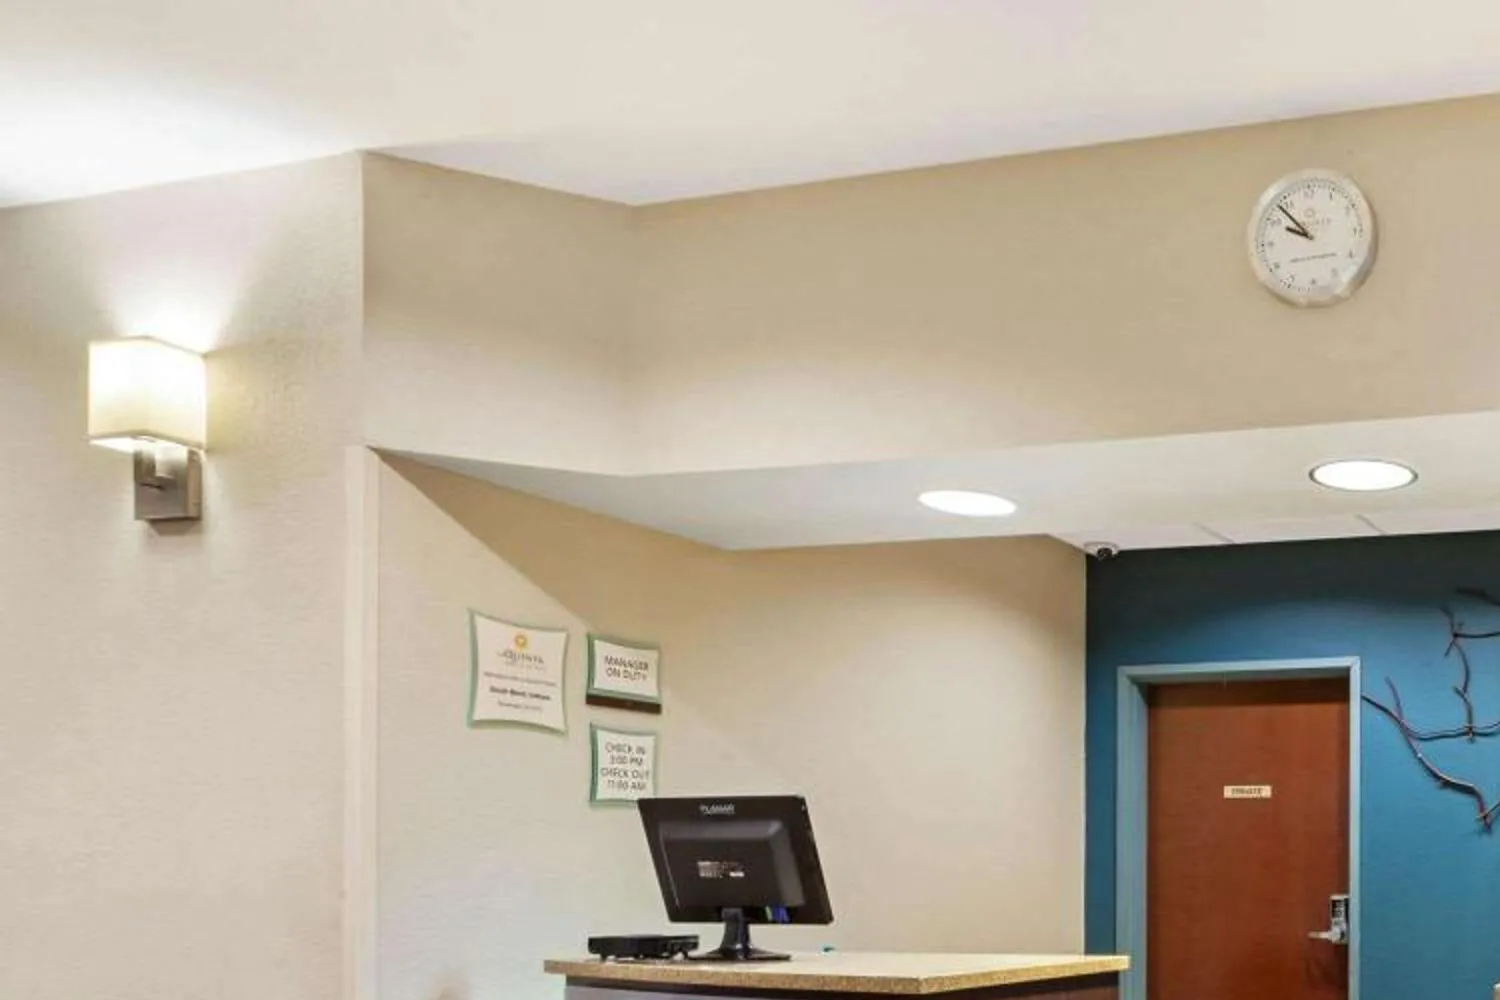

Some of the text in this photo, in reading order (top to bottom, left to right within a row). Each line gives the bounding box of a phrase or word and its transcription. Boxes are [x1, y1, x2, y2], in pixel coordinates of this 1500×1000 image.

[604, 655, 649, 671] MANAGER
[606, 667, 647, 681] ON DUTY
[605, 742, 632, 753] CHECK
[601, 767, 649, 780] CHECK OUT
